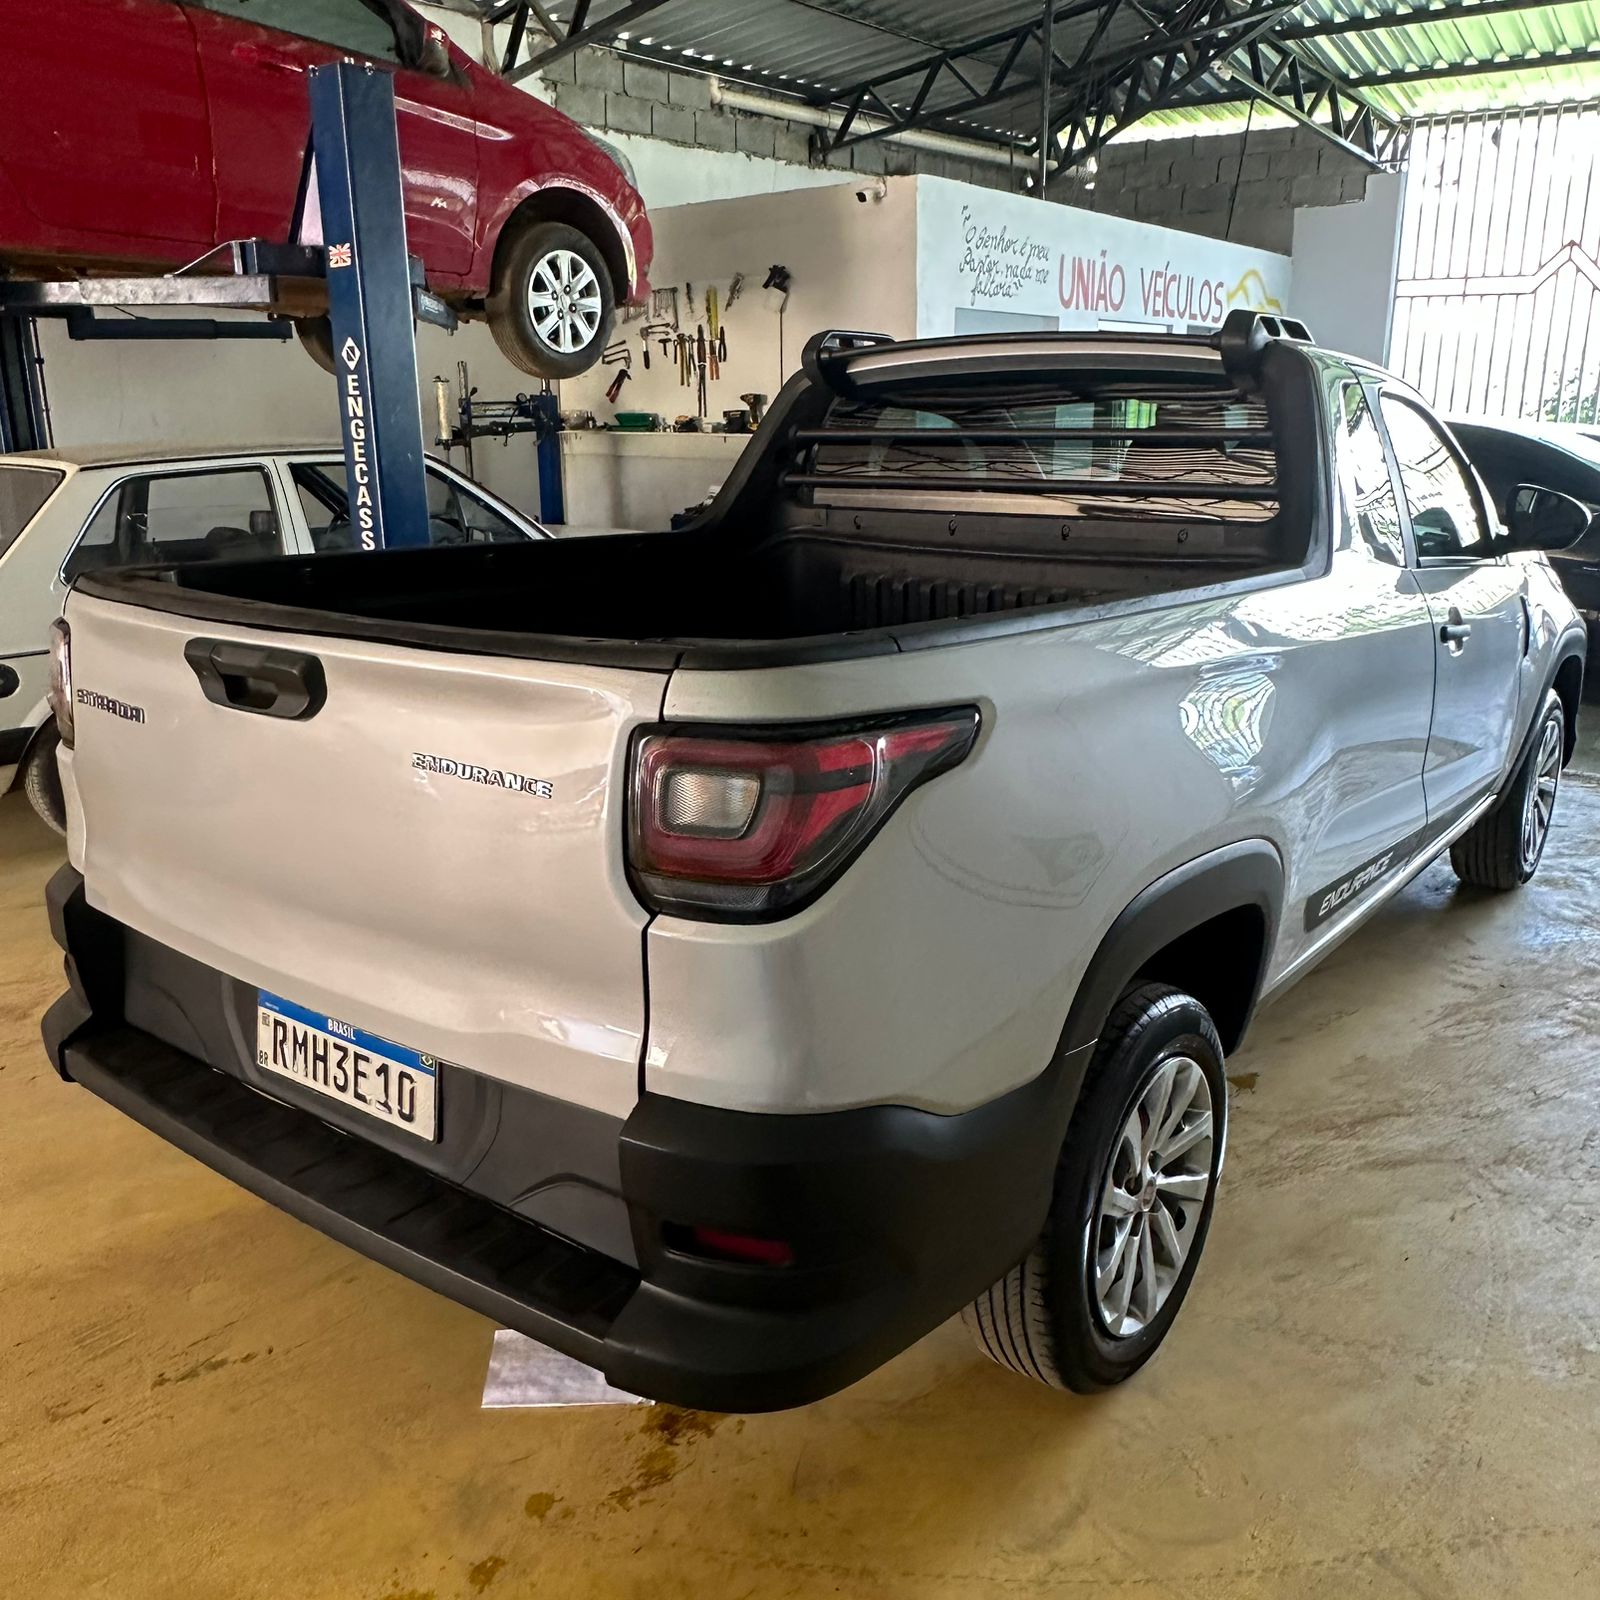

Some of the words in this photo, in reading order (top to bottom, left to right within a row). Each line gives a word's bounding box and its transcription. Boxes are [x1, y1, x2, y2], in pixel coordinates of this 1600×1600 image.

[975, 225, 1019, 255] Senhor
[1058, 249, 1126, 313] UNIÃO
[1140, 261, 1224, 324] VEÍCULOS
[346, 374, 376, 551] ENGECASS
[77, 688, 145, 724] STRADA
[411, 752, 554, 800] ENDURANCE
[327, 1018, 357, 1041] BRASIL
[258, 1049, 269, 1067] BR
[272, 1017, 416, 1123] RMH3E10
